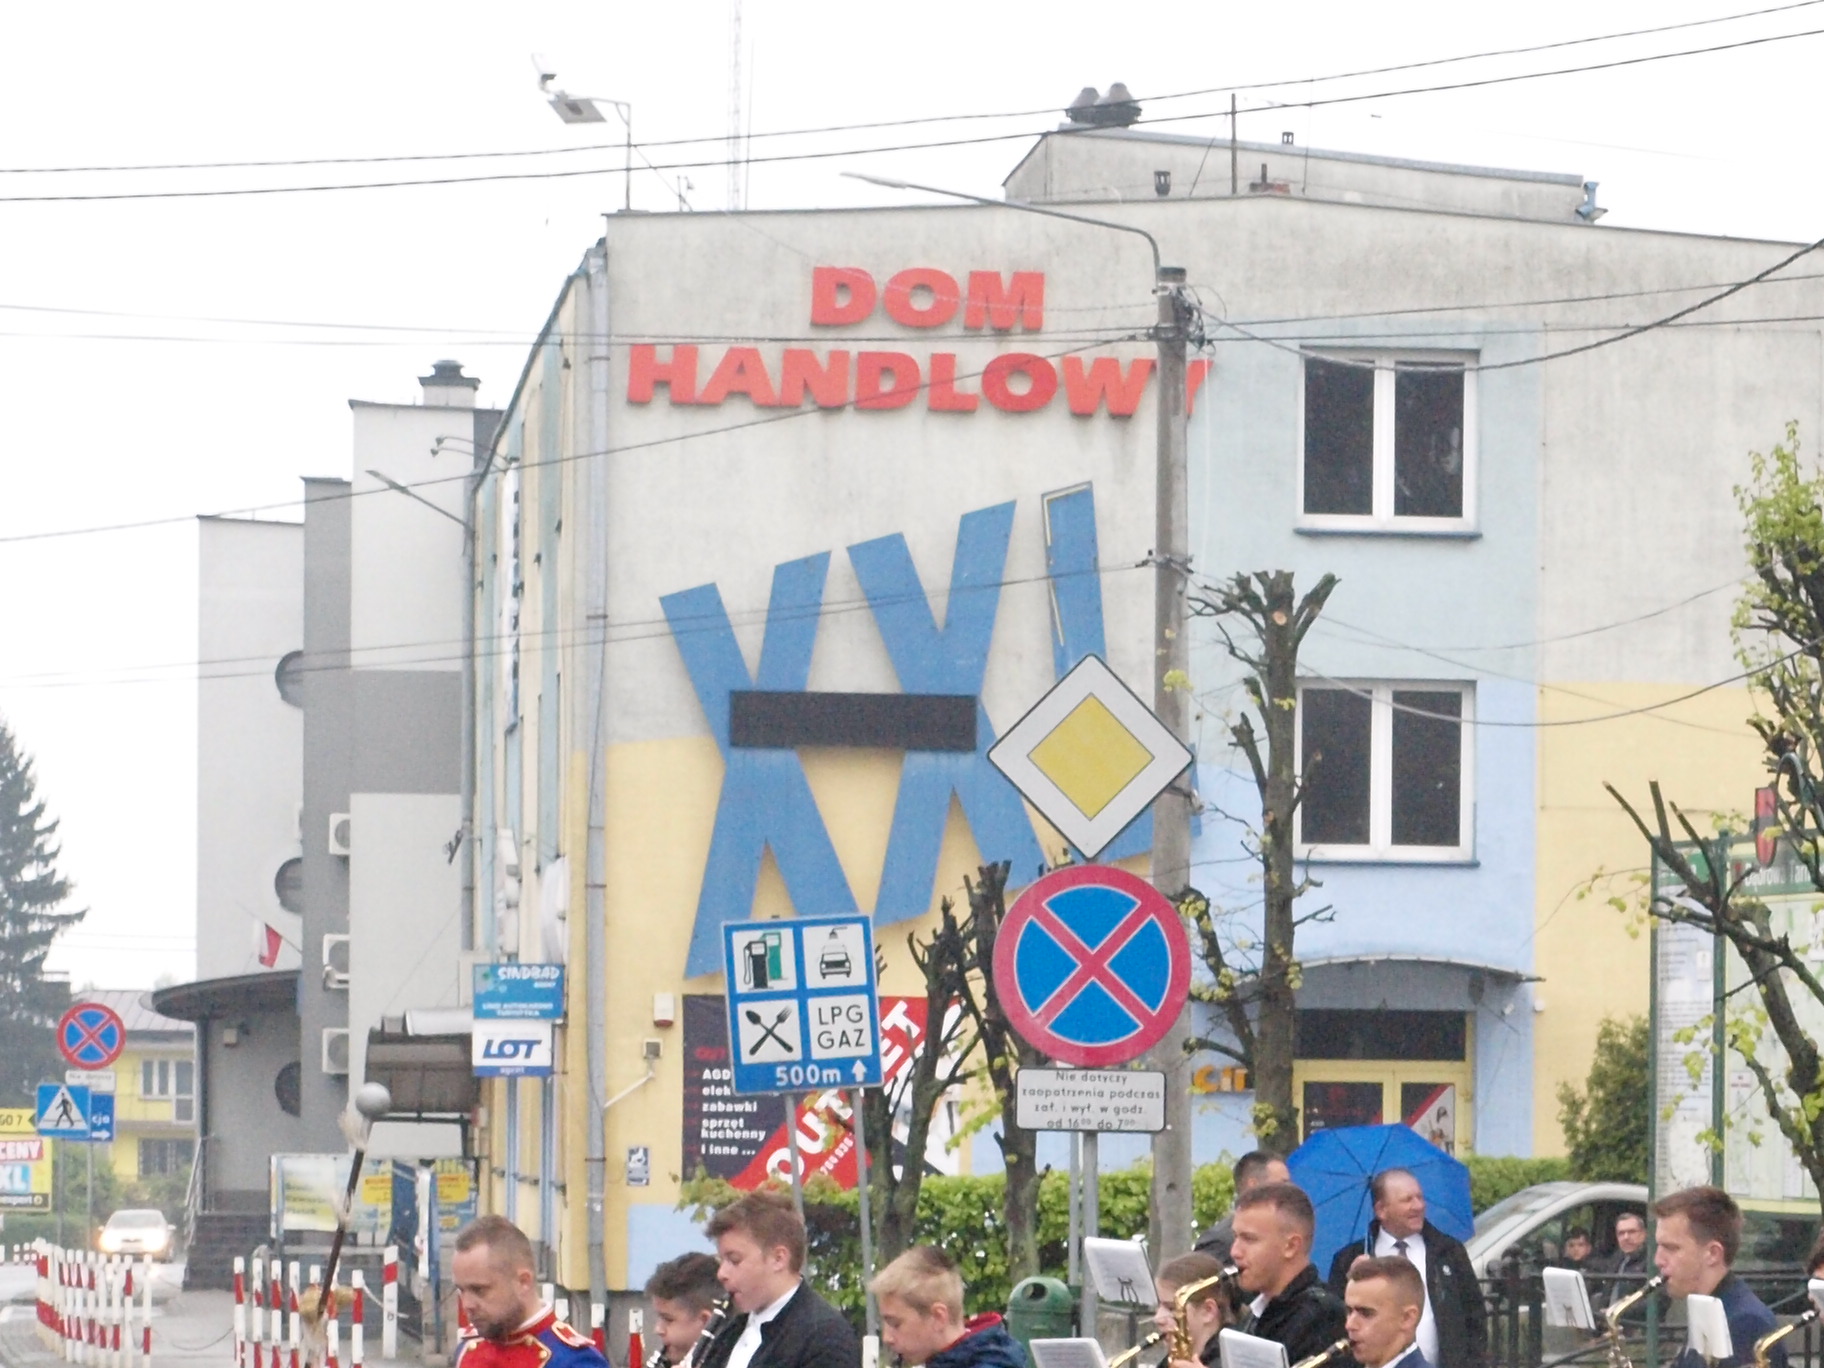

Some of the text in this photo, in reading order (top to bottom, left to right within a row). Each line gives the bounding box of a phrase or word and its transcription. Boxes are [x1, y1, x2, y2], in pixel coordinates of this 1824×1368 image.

[810, 265, 1046, 331] DOM
[818, 1004, 864, 1026] LPG
[482, 1039, 543, 1059] LOT
[817, 1028, 866, 1050] GAZ
[775, 1063, 842, 1087] 500m
[1055, 1071, 1128, 1086] Nie dotyczy
[766, 1001, 921, 1185] OUTET
[1109, 1088, 1161, 1099] podczas
[702, 1101, 758, 1113] zabawki
[1047, 1118, 1063, 1129] od
[1097, 1118, 1113, 1130] do
[701, 1128, 767, 1143] kuchenny
